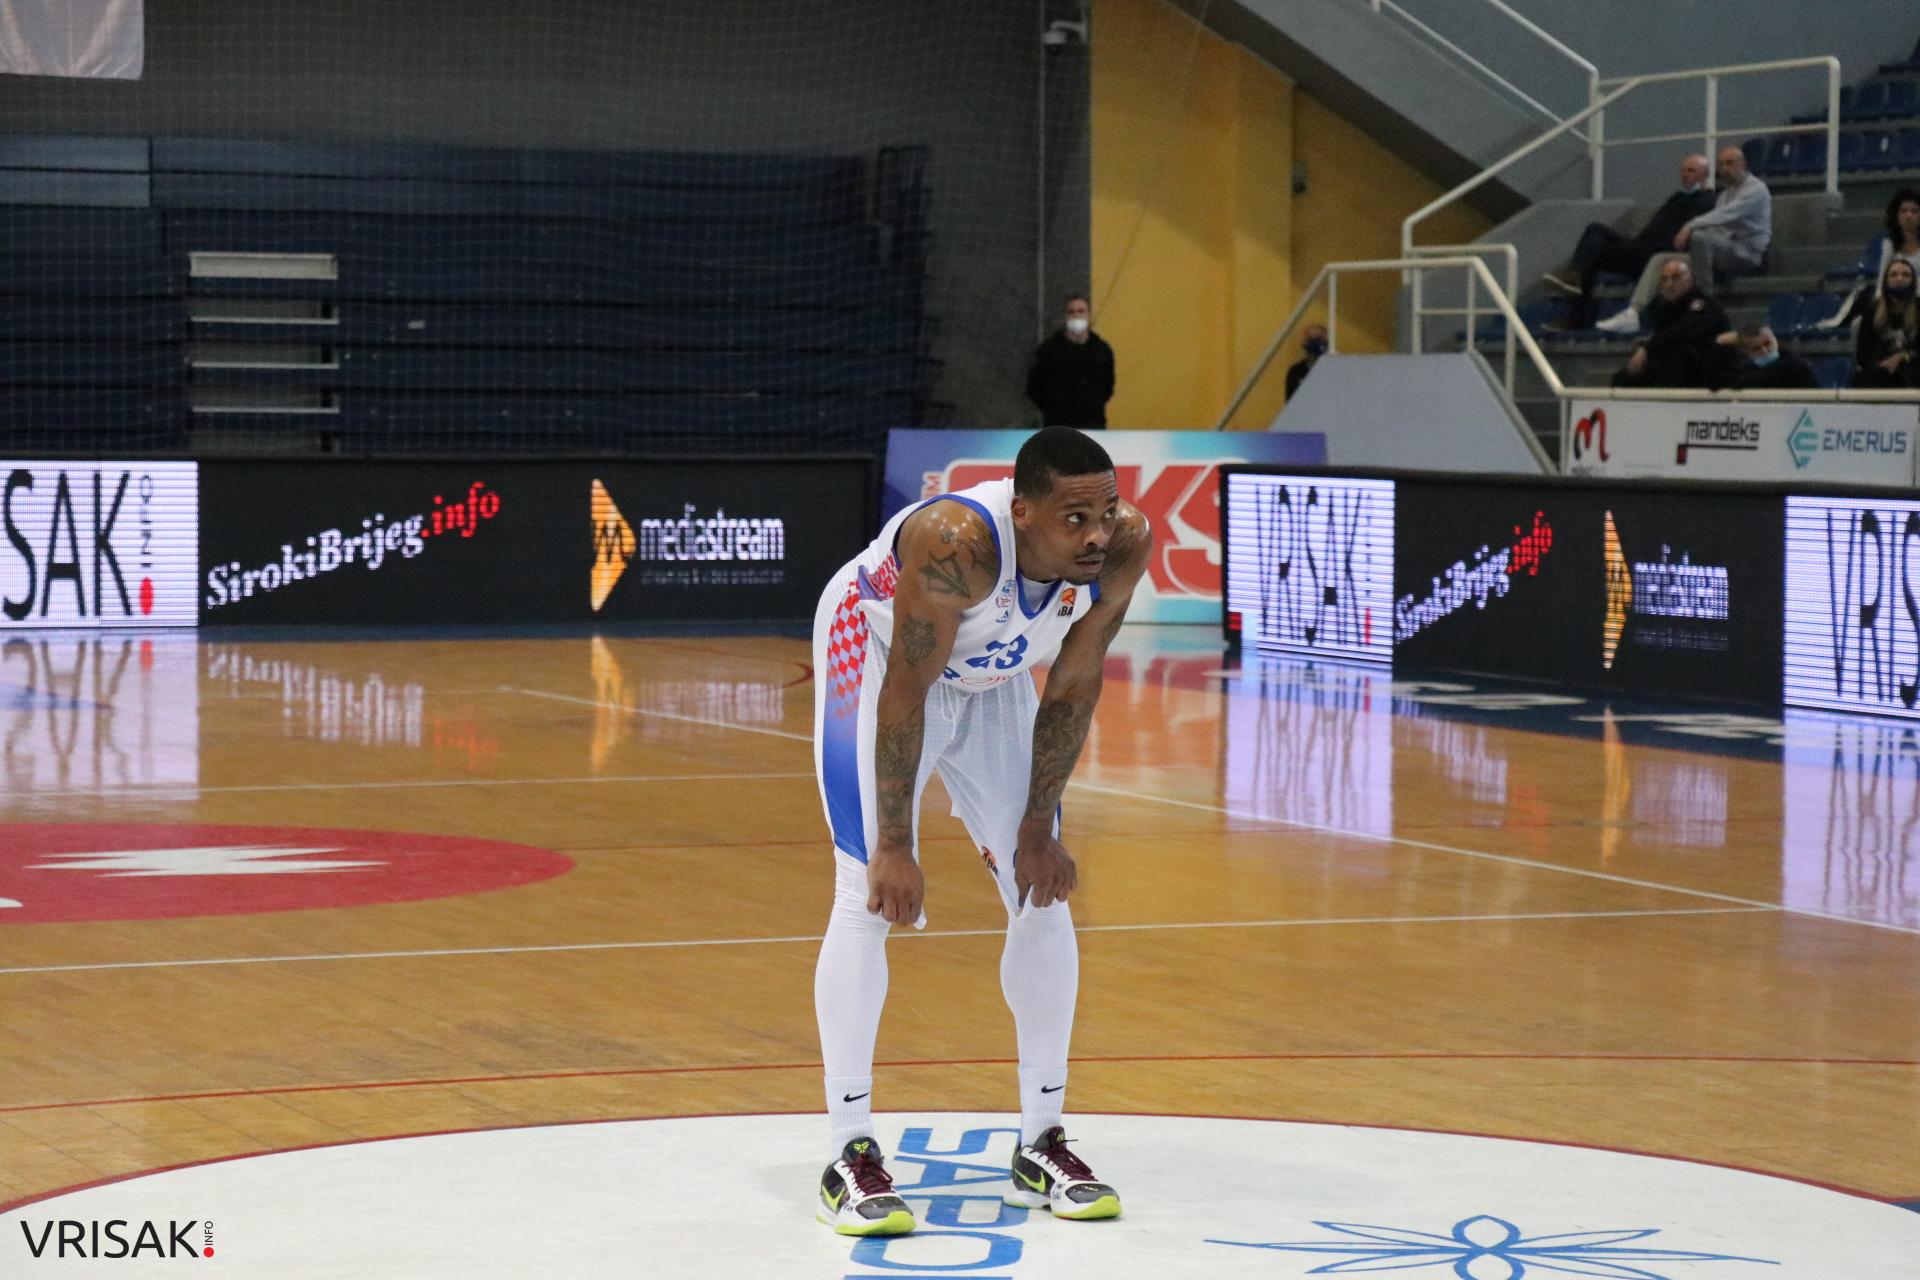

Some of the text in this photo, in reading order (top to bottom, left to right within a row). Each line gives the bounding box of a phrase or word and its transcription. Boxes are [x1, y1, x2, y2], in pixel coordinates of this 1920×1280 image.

[1687, 416, 1760, 442] mandeks
[1822, 428, 1907, 454] EMERUS
[1256, 483, 1362, 647] VRISAK
[964, 634, 1029, 670] 23
